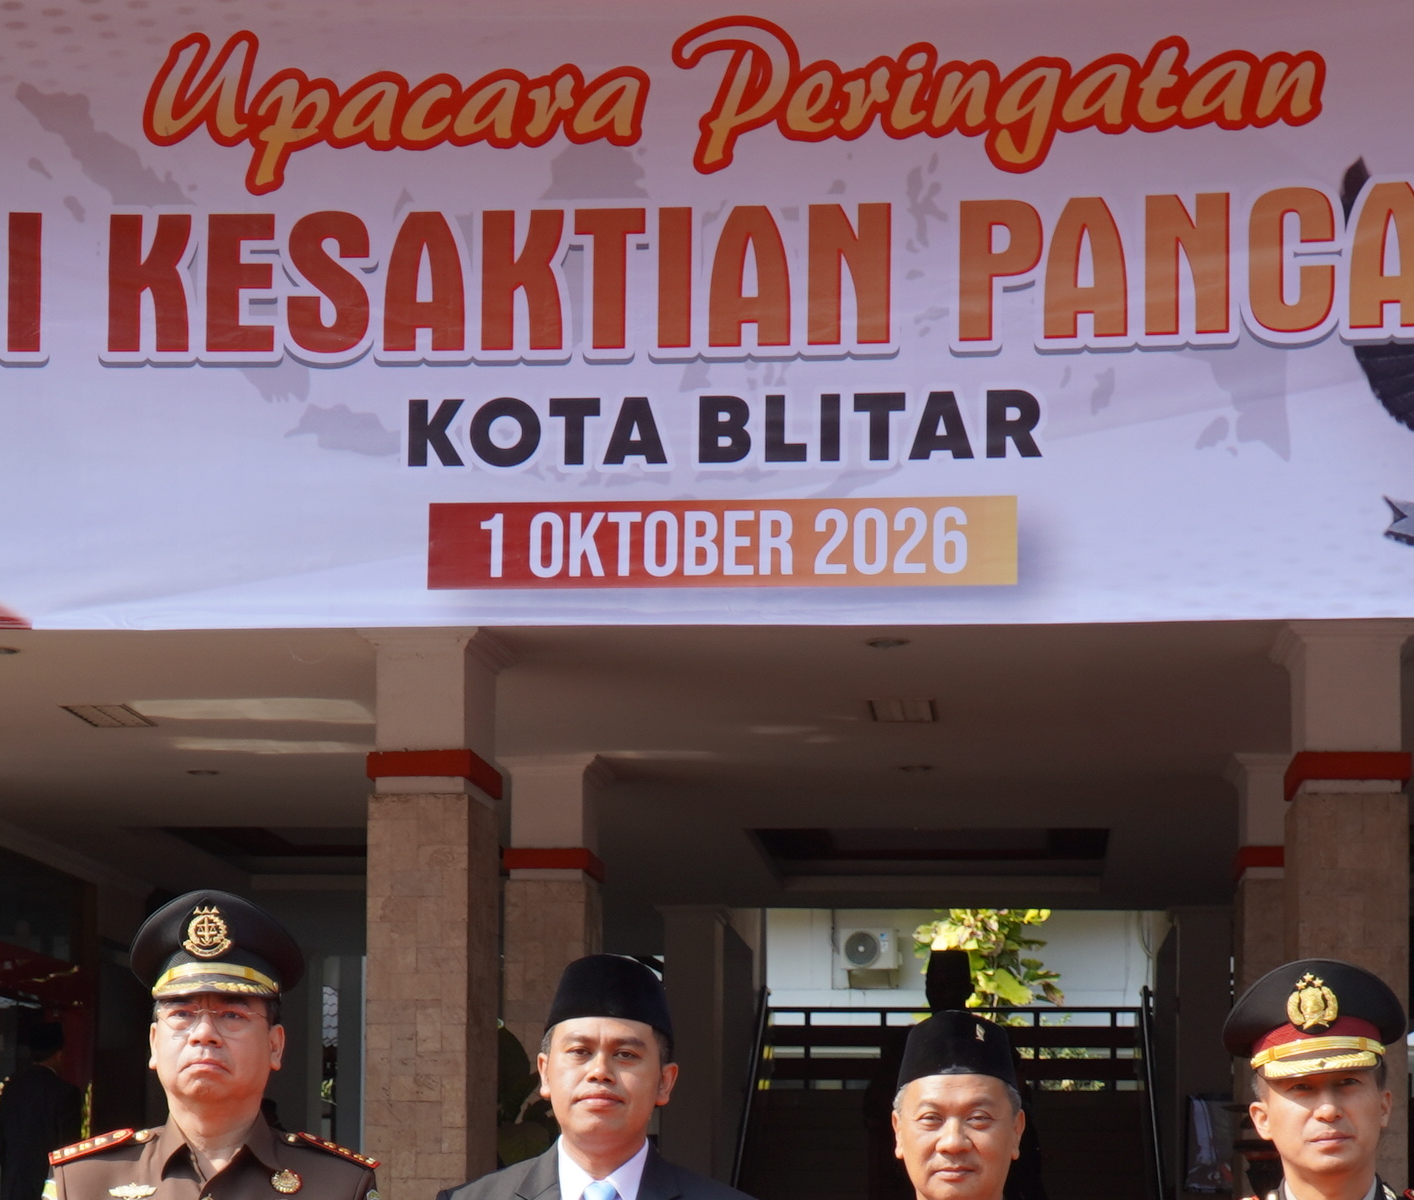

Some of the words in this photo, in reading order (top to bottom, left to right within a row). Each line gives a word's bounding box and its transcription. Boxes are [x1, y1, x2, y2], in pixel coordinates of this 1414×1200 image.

[144, 29, 651, 196] Upacara
[670, 14, 1327, 174] Peringatan
[106, 202, 893, 354] KESAKTIAN
[406, 396, 668, 468] KOTA
[698, 390, 1043, 466] BLITAR
[478, 513, 505, 579] 1
[528, 508, 794, 577] OKTOBER
[813, 505, 969, 575] 2026
